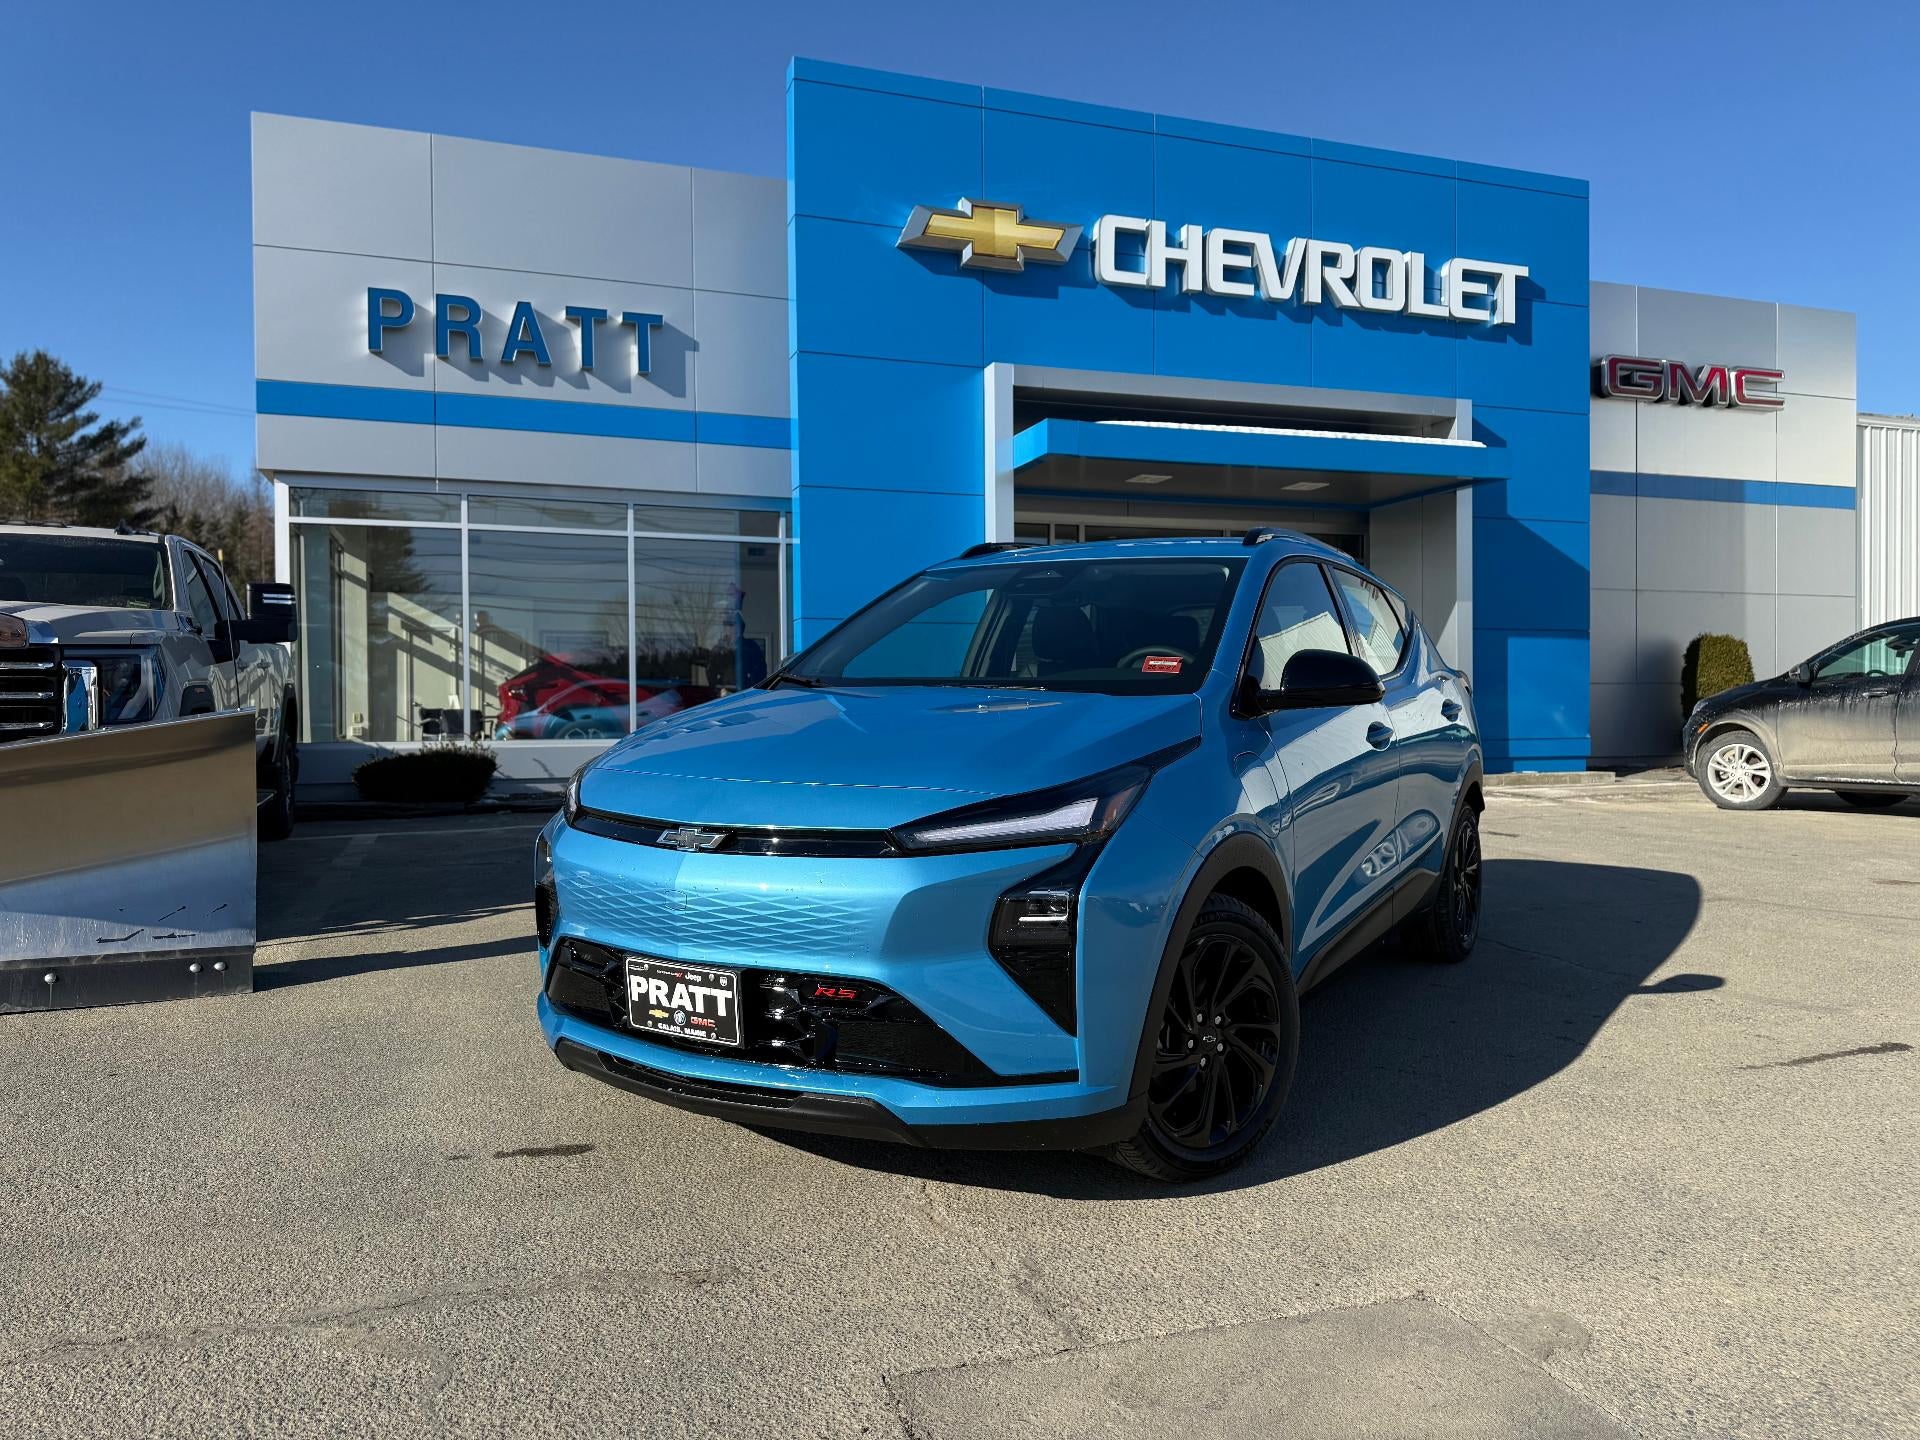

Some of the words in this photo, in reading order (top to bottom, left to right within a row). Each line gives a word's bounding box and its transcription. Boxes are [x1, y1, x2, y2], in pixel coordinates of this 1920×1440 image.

[1092, 214, 1529, 325] CHEVROLET
[367, 286, 664, 375] PRATT
[1601, 354, 1785, 412] GMC
[629, 974, 732, 1017] PRATT
[685, 972, 701, 983] Jeep
[815, 986, 856, 999] RS
[690, 1016, 716, 1028] GMC
